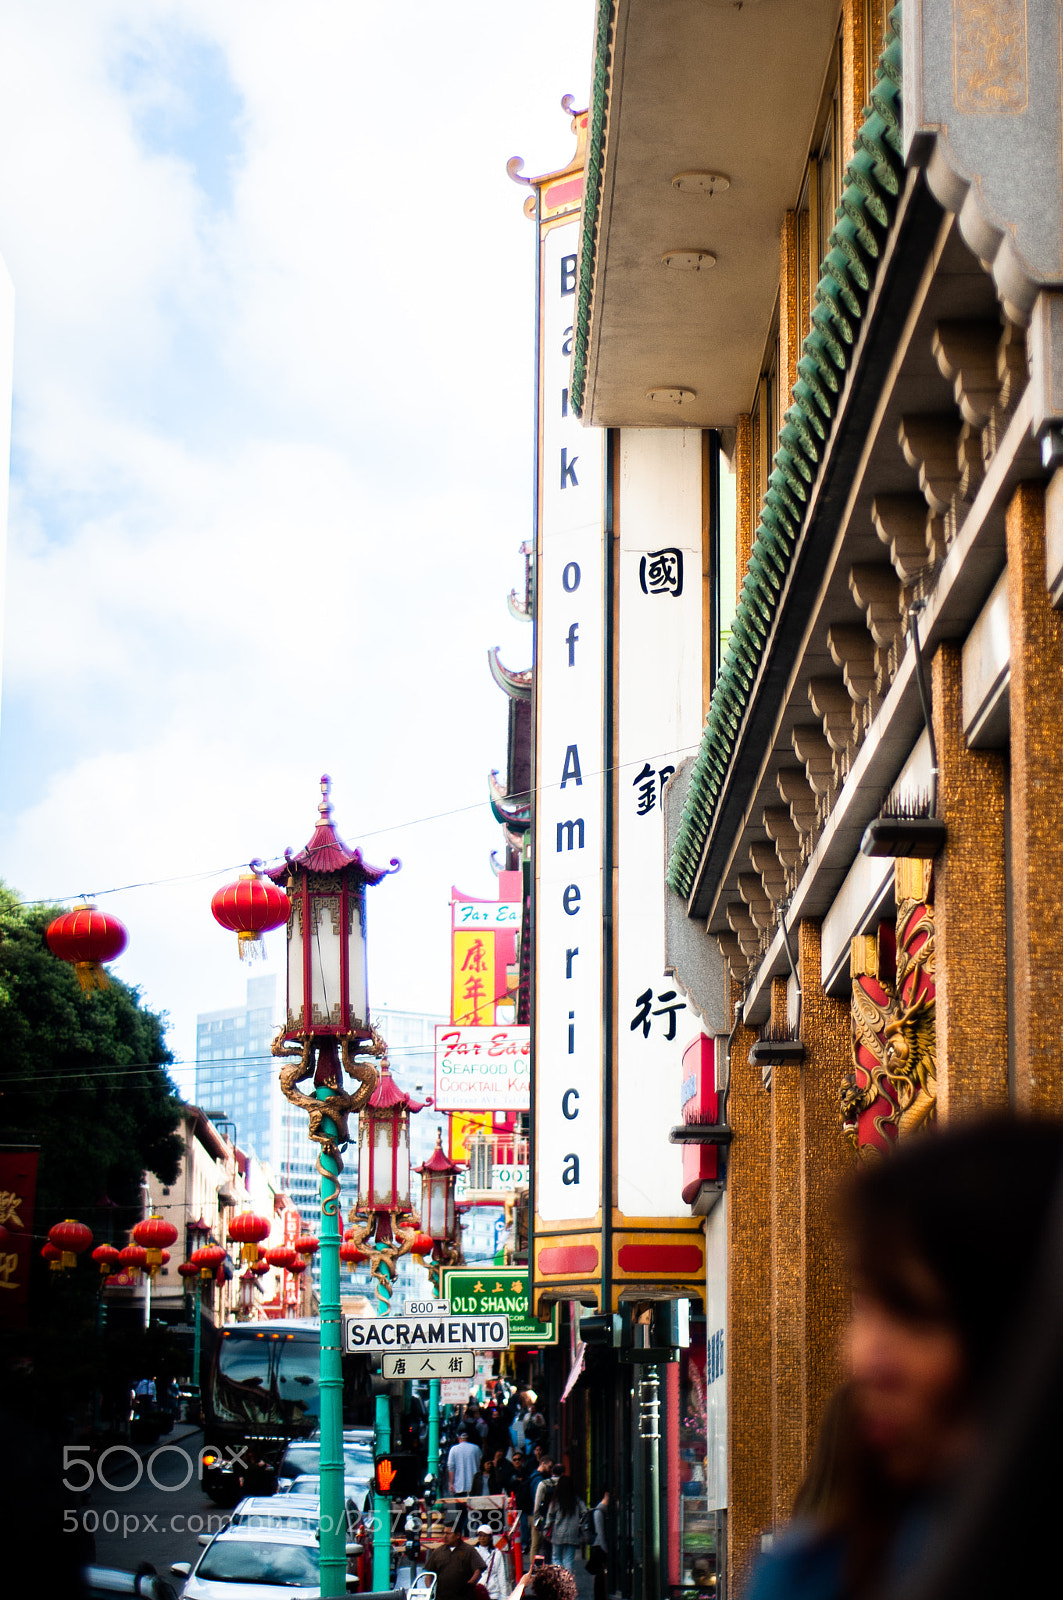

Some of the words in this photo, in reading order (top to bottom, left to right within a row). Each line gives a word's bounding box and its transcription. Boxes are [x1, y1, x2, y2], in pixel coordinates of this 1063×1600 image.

[561, 560, 582, 668] of
[460, 905, 489, 922] Far
[496, 905, 521, 922] Ea
[556, 744, 586, 1186] America
[441, 1031, 482, 1058] Far
[410, 1302, 434, 1314] 800
[452, 1297, 477, 1313] OLD
[351, 1321, 504, 1346] SACRAMENTO
[392, 1356, 464, 1375] 唐人街
